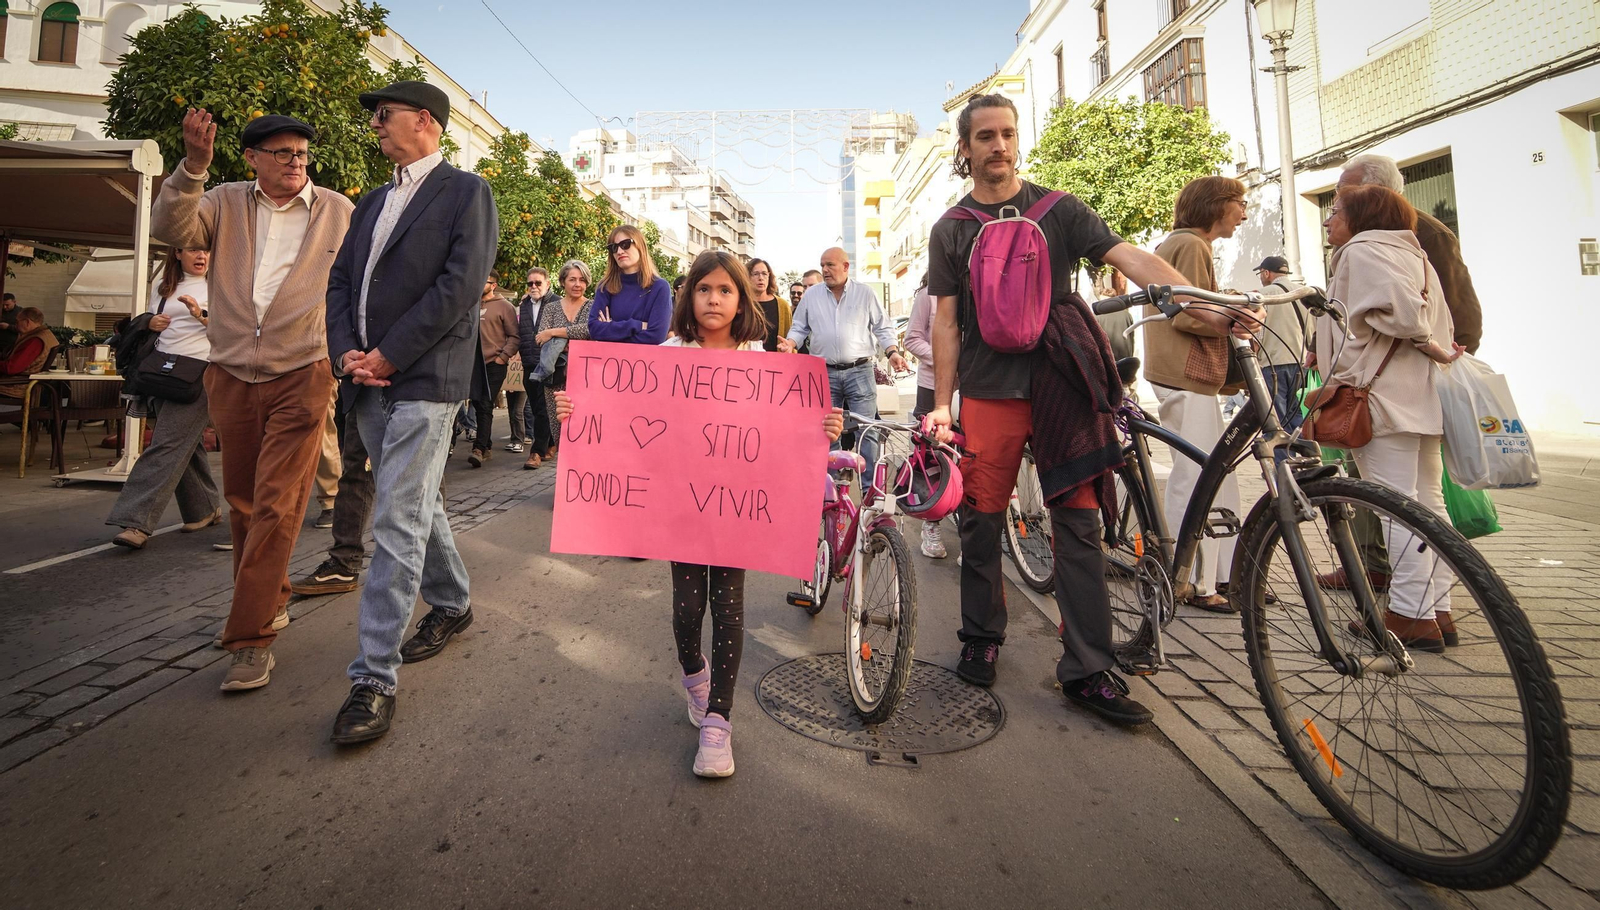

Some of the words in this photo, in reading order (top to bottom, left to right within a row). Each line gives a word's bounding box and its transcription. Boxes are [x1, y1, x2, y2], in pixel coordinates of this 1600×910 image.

[1532, 151, 1543, 162] 25
[578, 355, 659, 395] TODOS
[671, 363, 825, 408] NECESITAN
[566, 413, 603, 444] UN
[565, 469, 650, 509] DONDE
